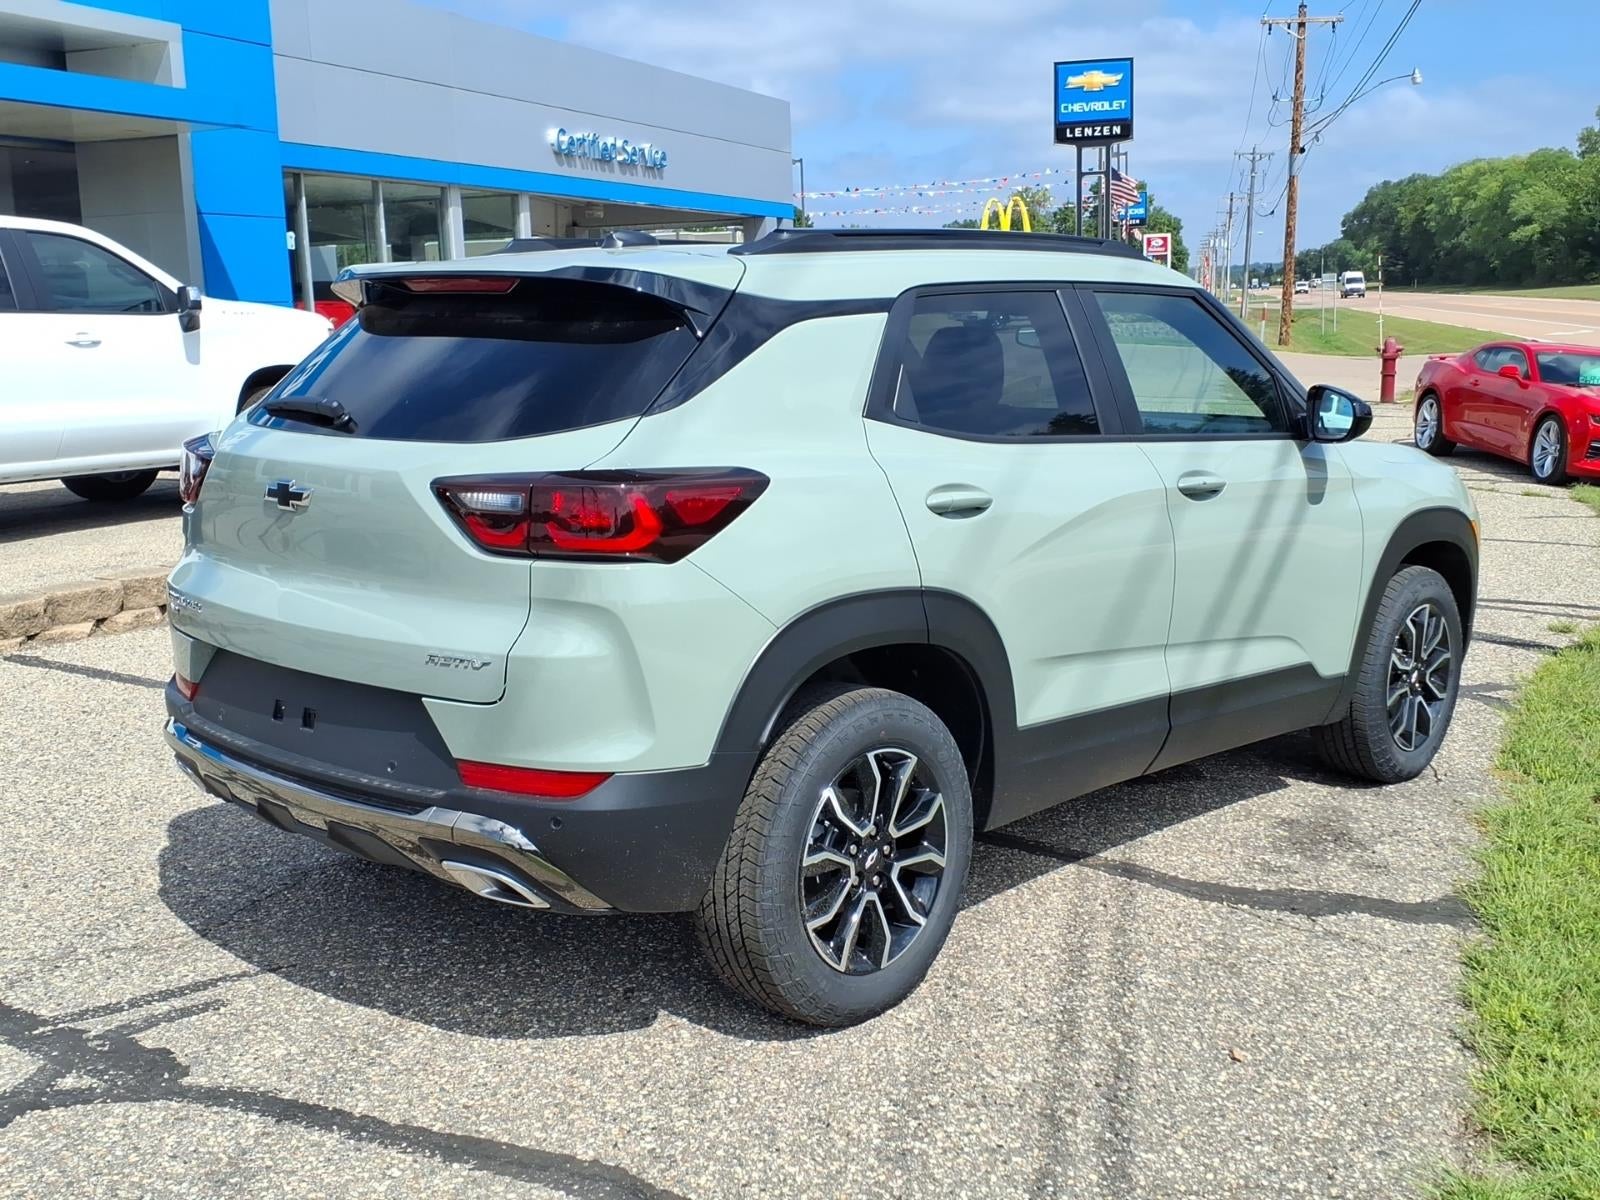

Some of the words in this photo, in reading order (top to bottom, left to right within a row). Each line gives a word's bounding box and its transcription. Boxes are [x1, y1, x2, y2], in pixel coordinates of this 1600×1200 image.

[1061, 99, 1127, 113] CHEVROLET
[1066, 125, 1121, 137] LENZEN
[556, 127, 618, 161] Certified
[620, 138, 668, 168] Service
